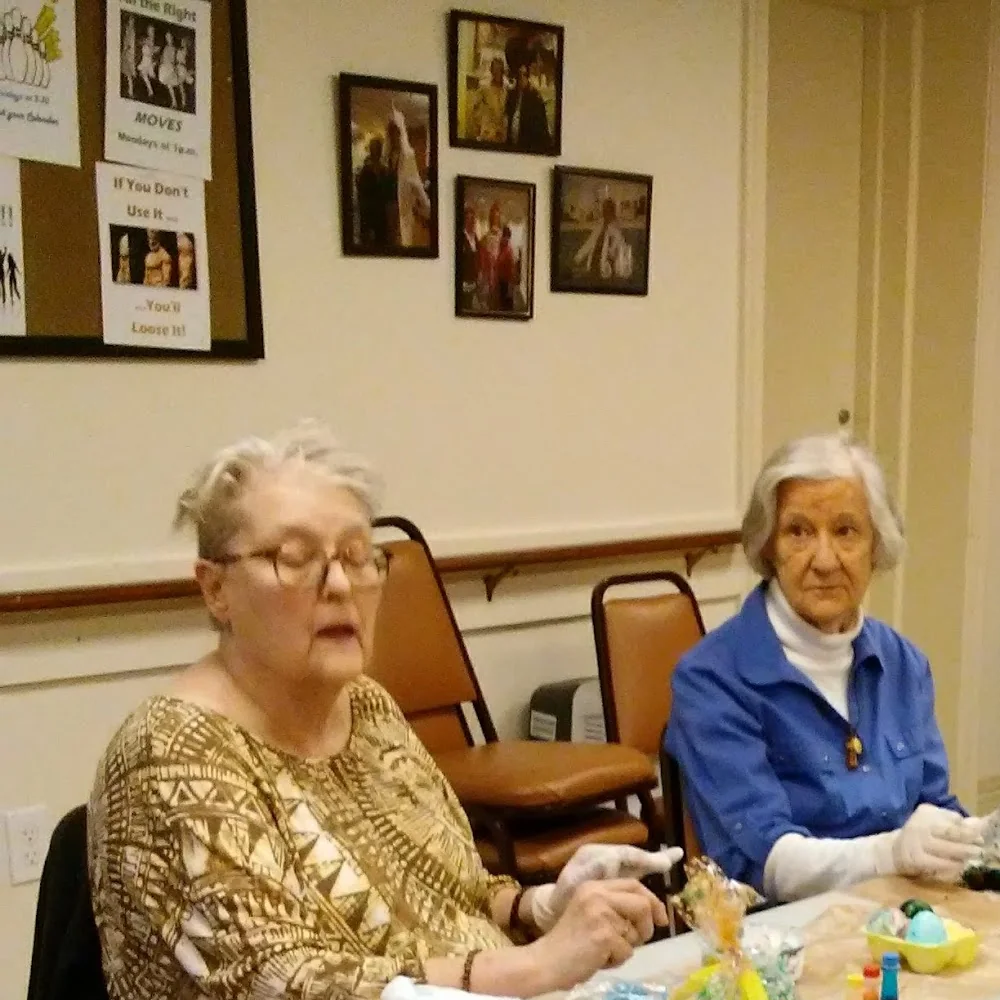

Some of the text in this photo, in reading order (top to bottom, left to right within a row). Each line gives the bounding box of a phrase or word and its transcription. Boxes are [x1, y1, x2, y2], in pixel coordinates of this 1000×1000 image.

[163, 2, 197, 22] Right
[135, 111, 183, 132] MOVES
[117, 131, 158, 152] Mondays
[113, 177, 189, 198] If You Don't
[127, 204, 151, 218] Use
[130, 321, 187, 337] Loose It!
